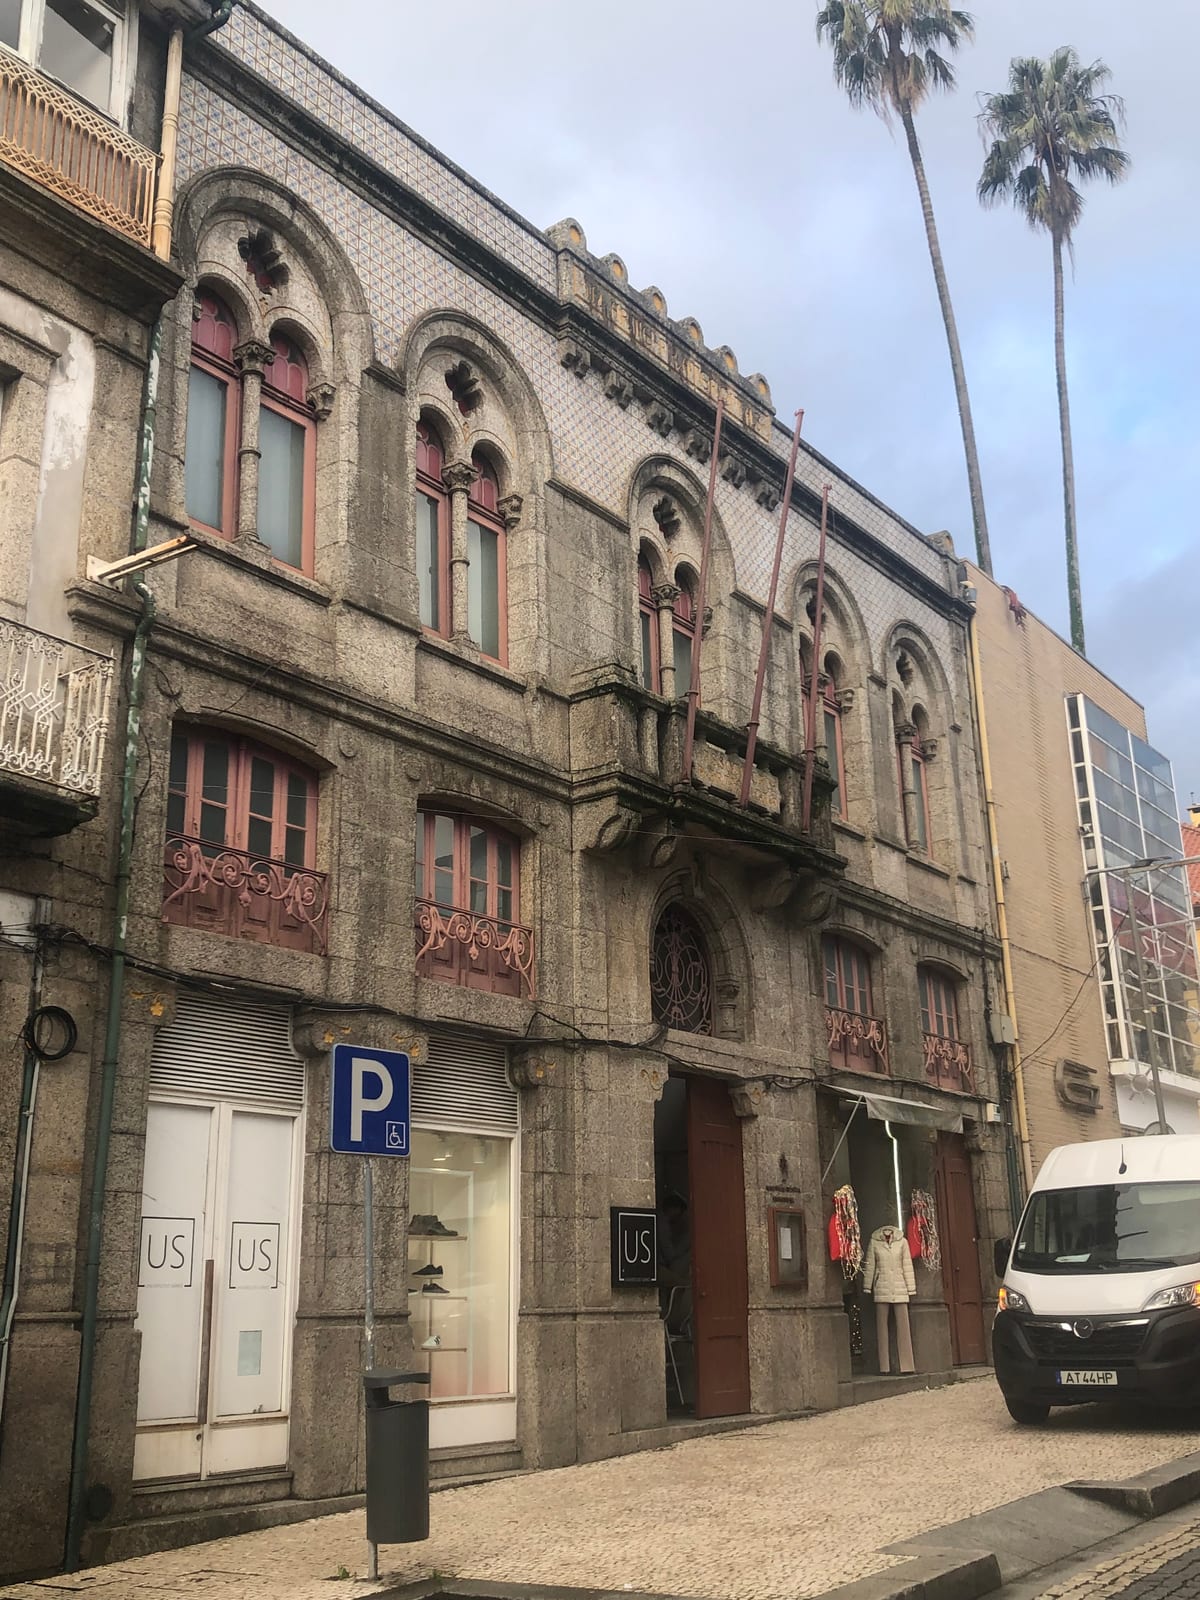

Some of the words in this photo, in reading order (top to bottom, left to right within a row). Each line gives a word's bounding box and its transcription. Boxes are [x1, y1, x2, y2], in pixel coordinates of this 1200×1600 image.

[350, 1057, 394, 1142] P
[147, 1234, 185, 1269] US
[238, 1239, 272, 1272] US
[624, 1229, 651, 1264] US
